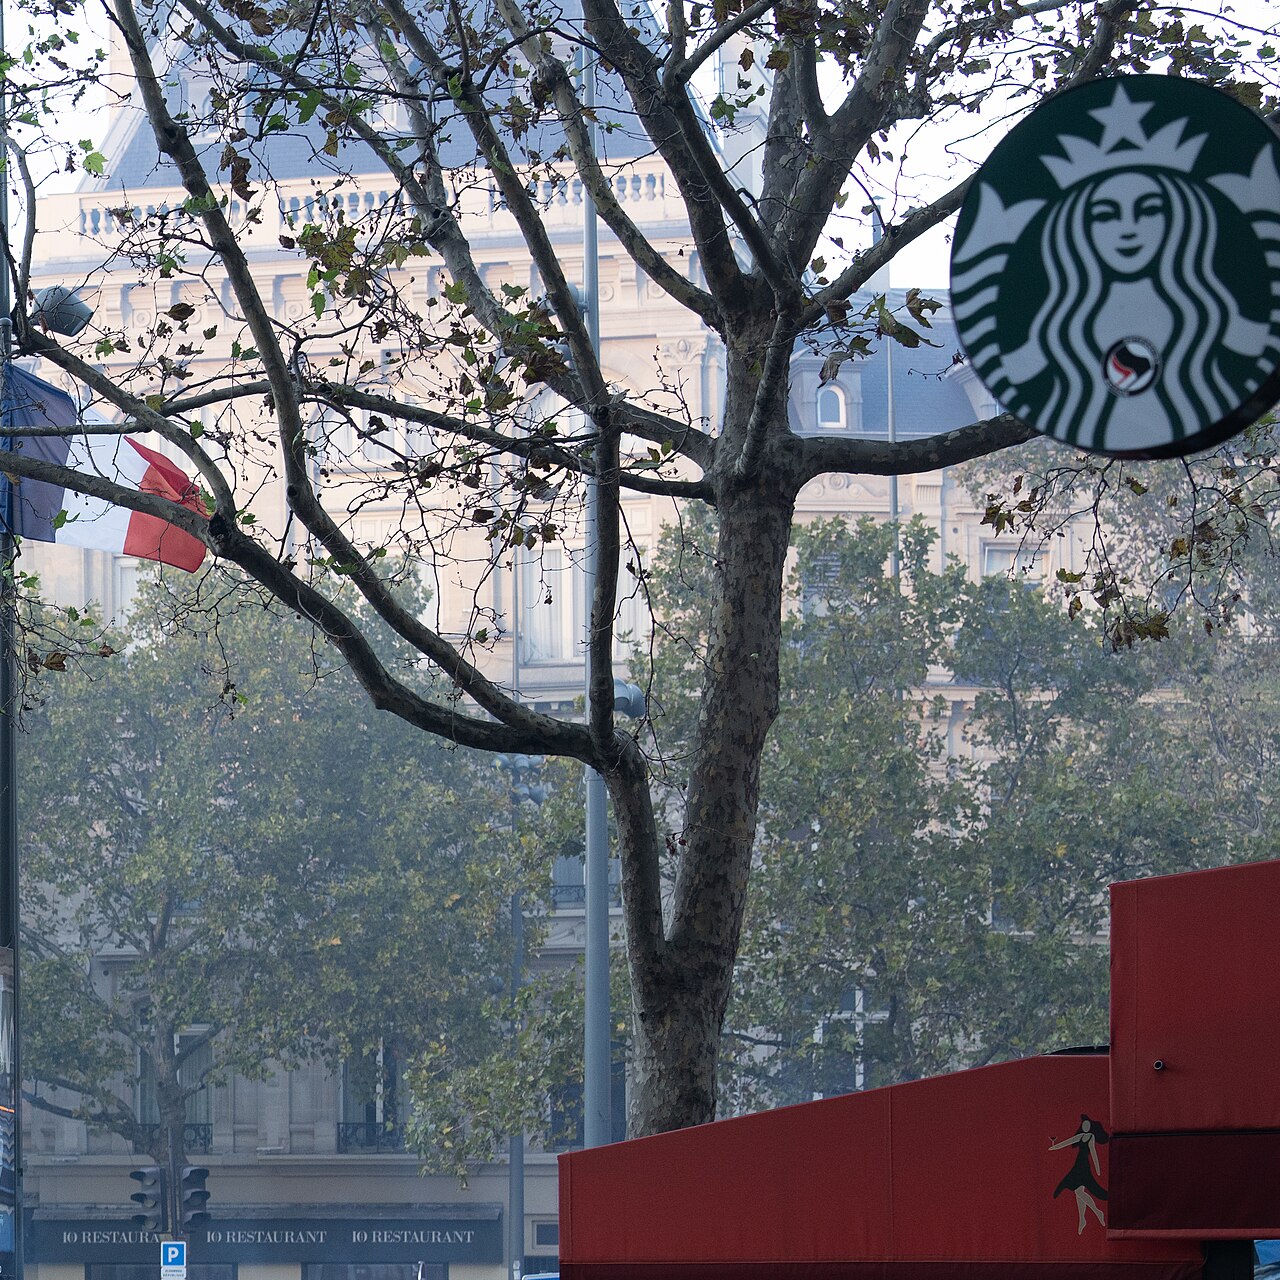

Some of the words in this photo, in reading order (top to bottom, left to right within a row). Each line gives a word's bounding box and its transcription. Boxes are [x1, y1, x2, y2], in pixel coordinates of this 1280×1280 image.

[82, 1231, 160, 1244] RESTAURA
[226, 1231, 327, 1244] RESTAURANT
[372, 1230, 475, 1243] RESTAURANT
[167, 1246, 180, 1263] P
